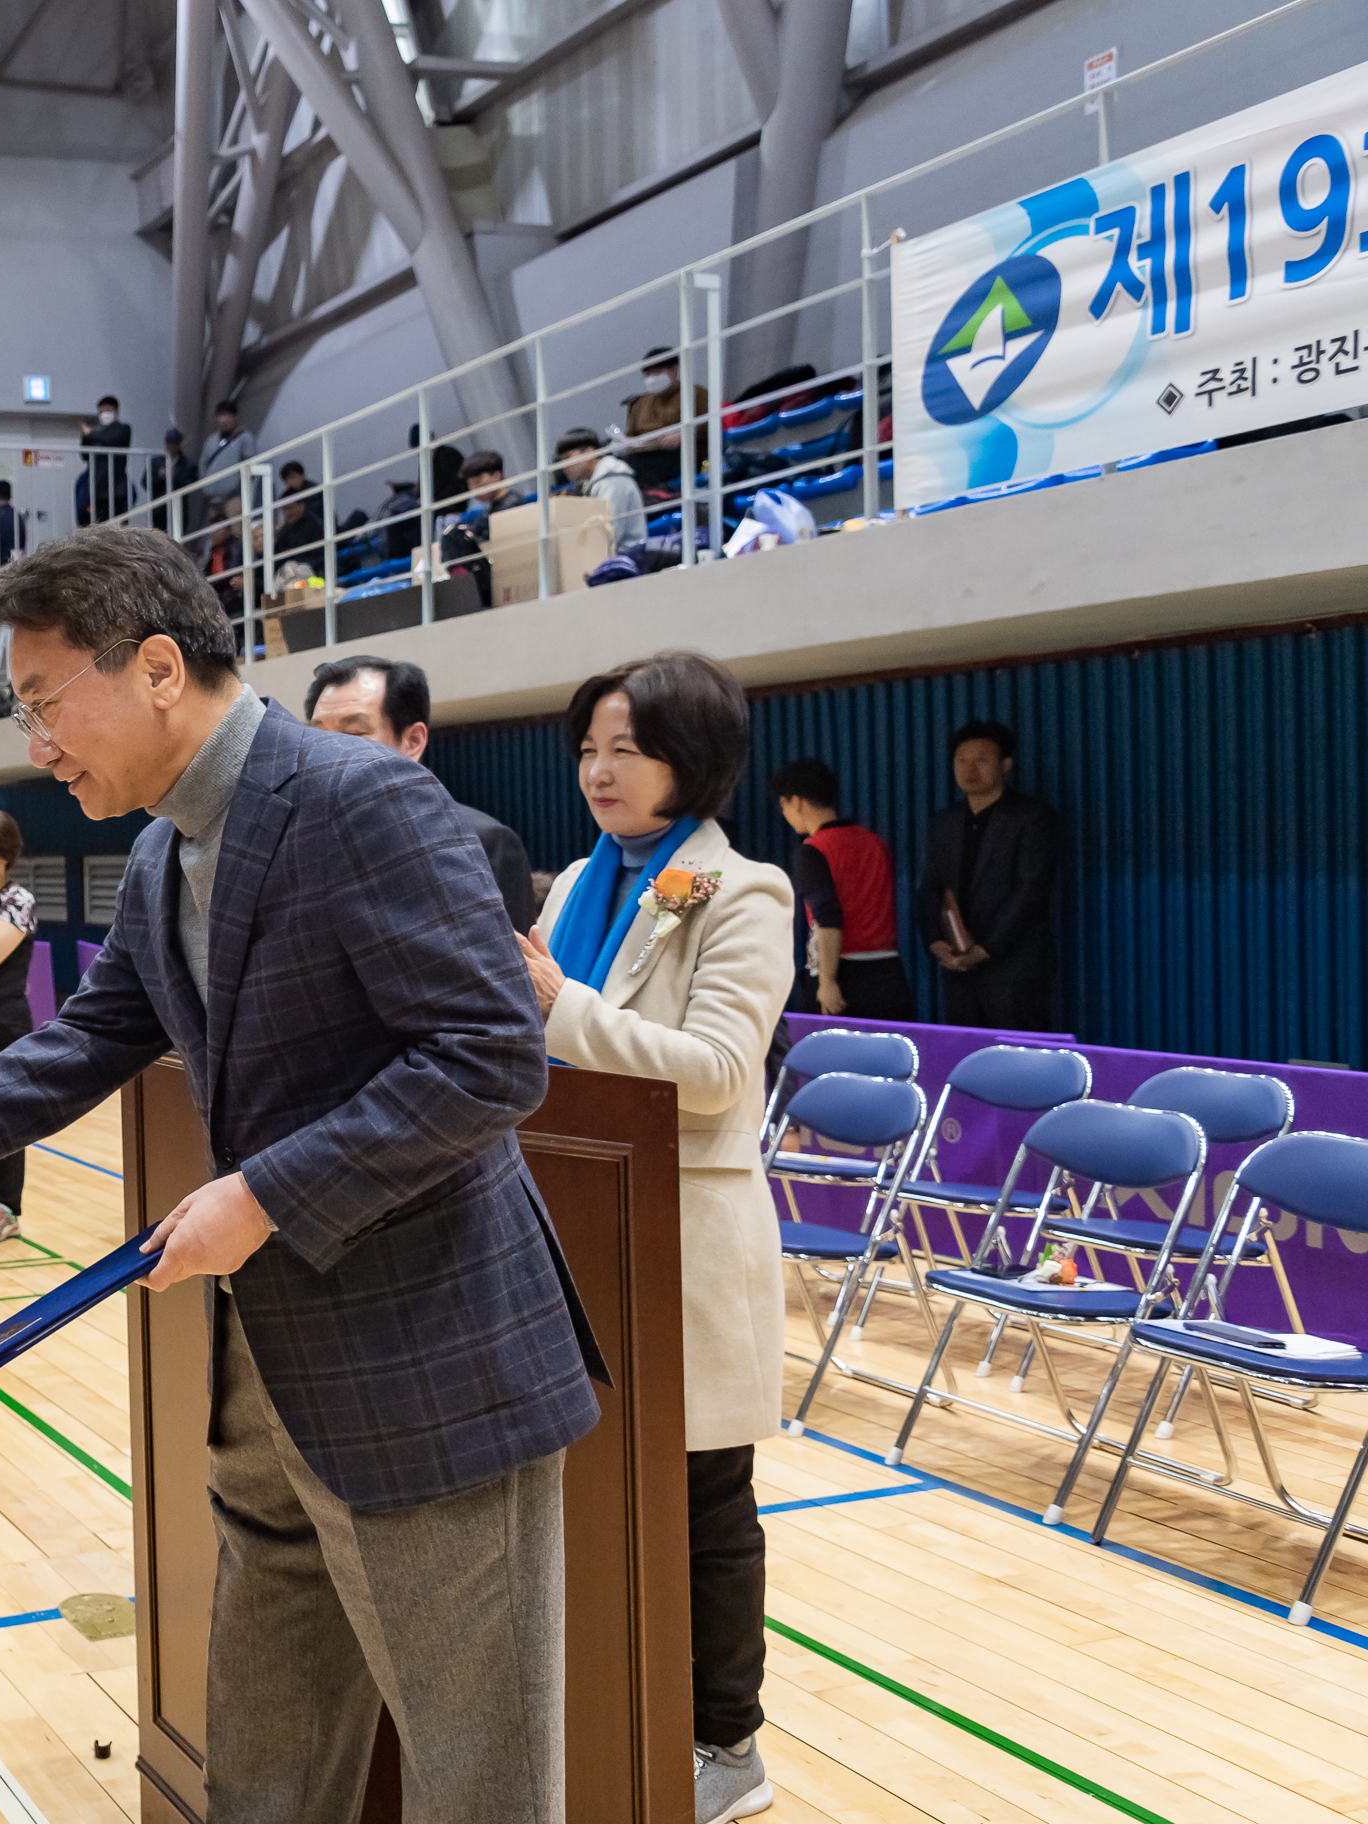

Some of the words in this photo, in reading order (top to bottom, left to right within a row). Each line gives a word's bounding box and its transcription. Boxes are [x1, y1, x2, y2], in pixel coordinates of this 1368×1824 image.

[1088, 133, 1368, 336] 제19
[1194, 356, 1258, 408] 주최
[1290, 329, 1368, 385] 광진
